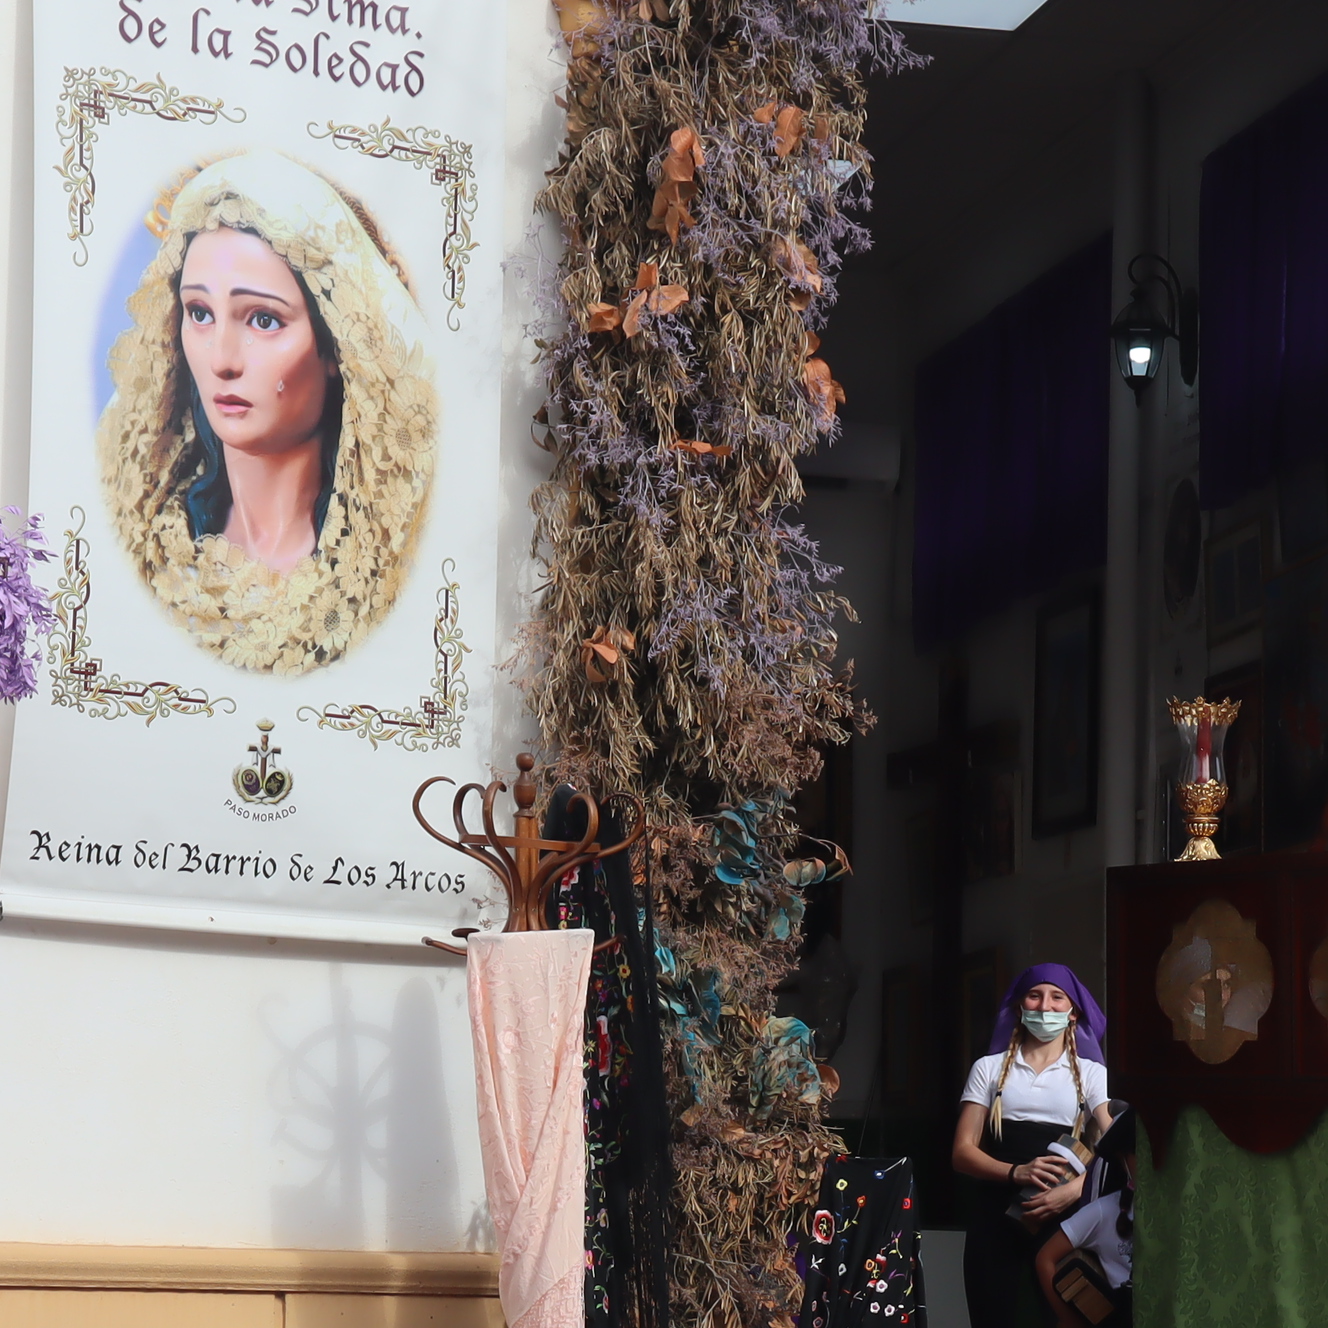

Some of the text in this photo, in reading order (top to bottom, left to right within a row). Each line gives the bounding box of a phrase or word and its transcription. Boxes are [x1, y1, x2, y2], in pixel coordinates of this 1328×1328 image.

[118, 0, 425, 98] de la Soledad
[224, 798, 297, 822] PASO MORADO
[29, 829, 466, 895] Reina del Barrio de Los Arcos
